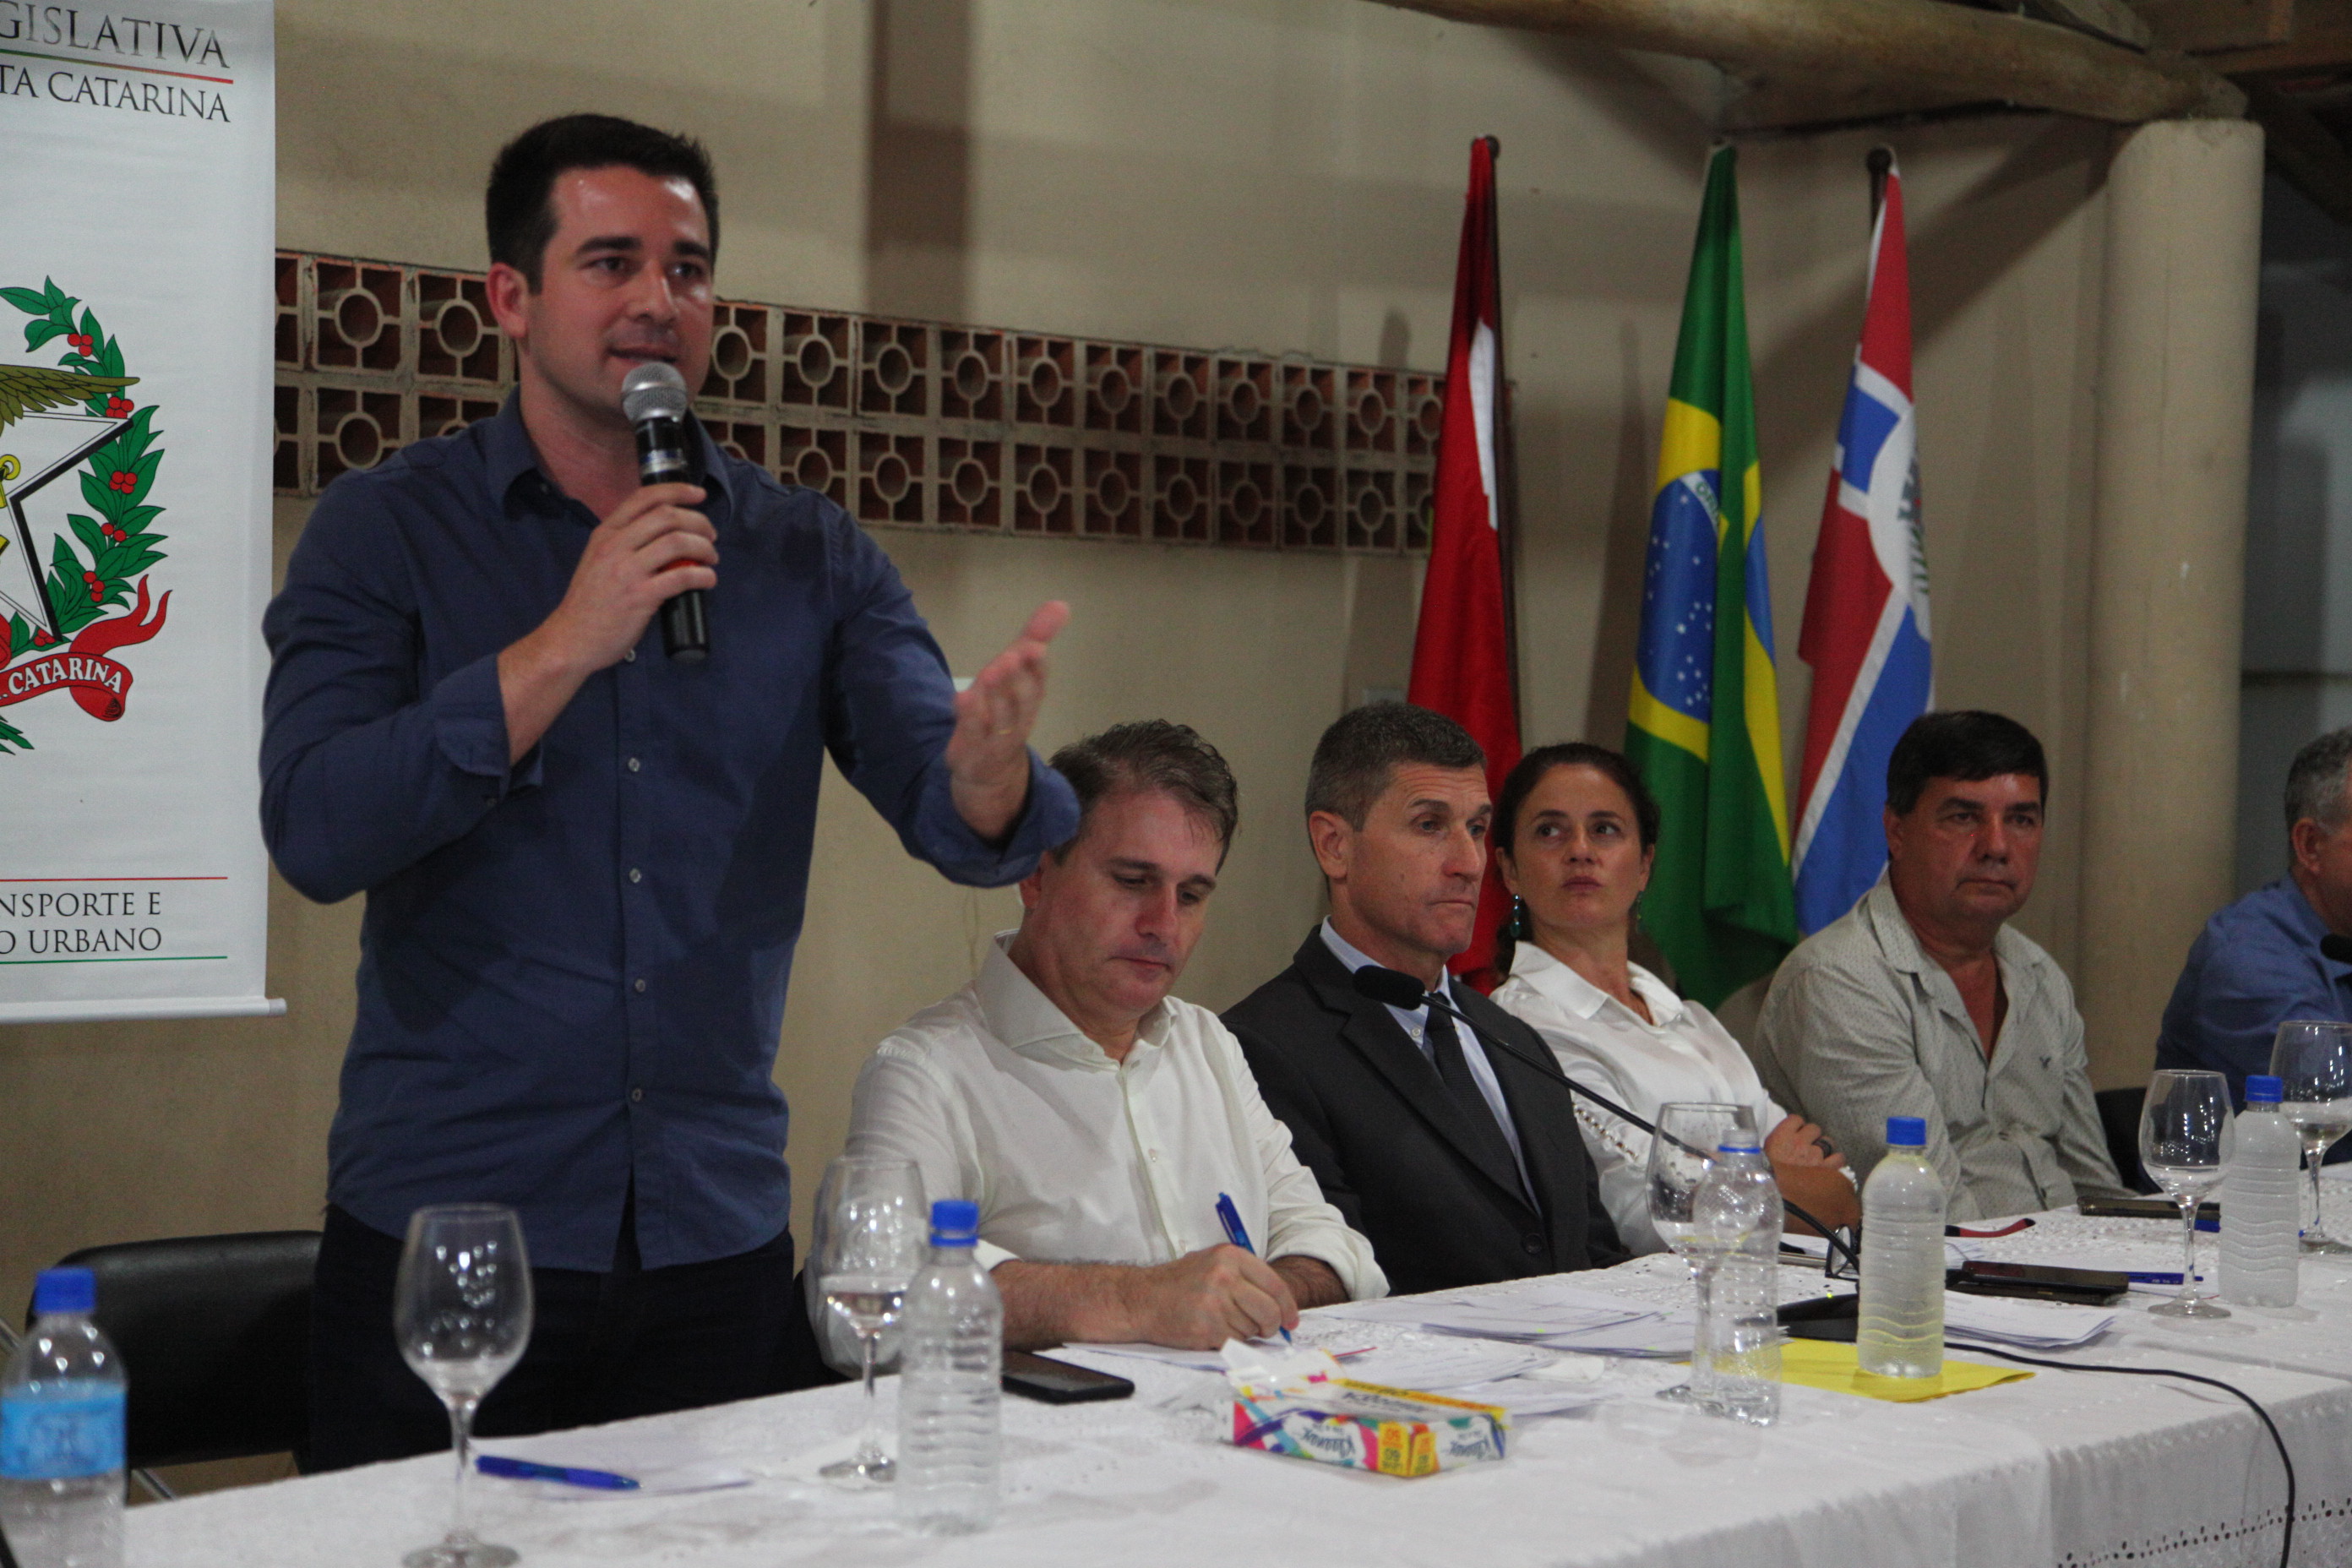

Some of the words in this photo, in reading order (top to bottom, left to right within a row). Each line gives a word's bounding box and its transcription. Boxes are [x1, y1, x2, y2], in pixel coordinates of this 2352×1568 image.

[0, 0, 231, 68] GISLATIVA
[47, 71, 231, 122] CATARINA
[8, 656, 122, 695] CATARINA
[148, 891, 161, 916] E
[28, 927, 162, 954] URBANO
